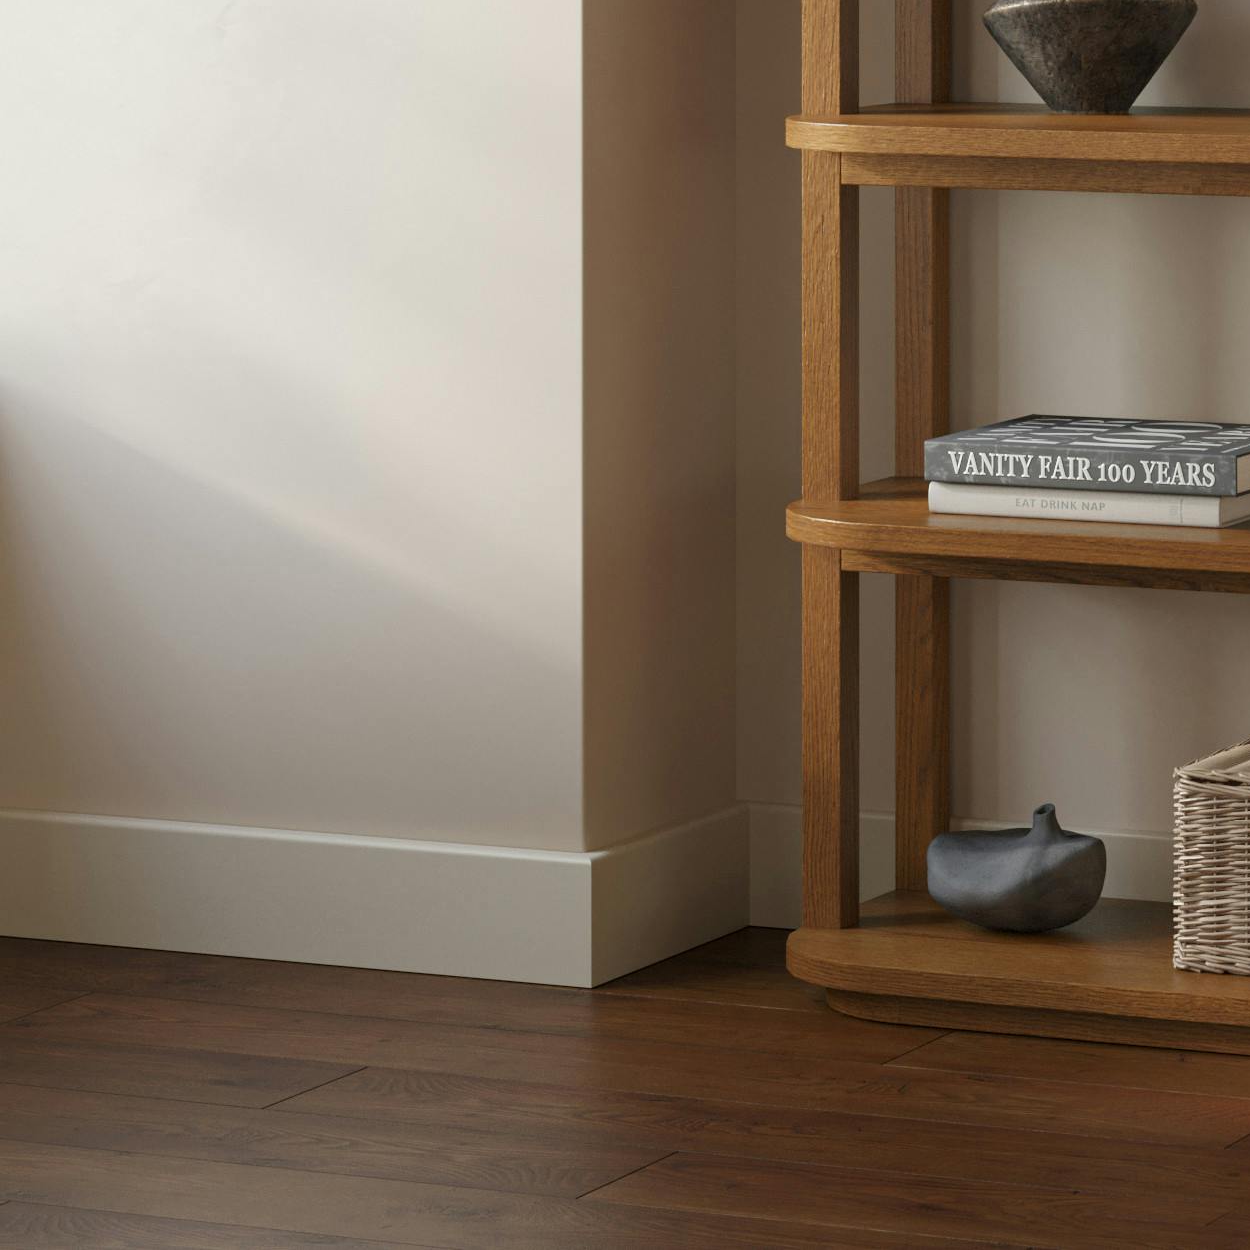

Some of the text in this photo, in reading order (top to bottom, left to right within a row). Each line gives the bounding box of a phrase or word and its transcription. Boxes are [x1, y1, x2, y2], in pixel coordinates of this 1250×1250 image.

[948, 451, 1216, 487] VANITY FAIR 100 YEARS
[1015, 498, 1107, 511] EAT DRINK NAP
